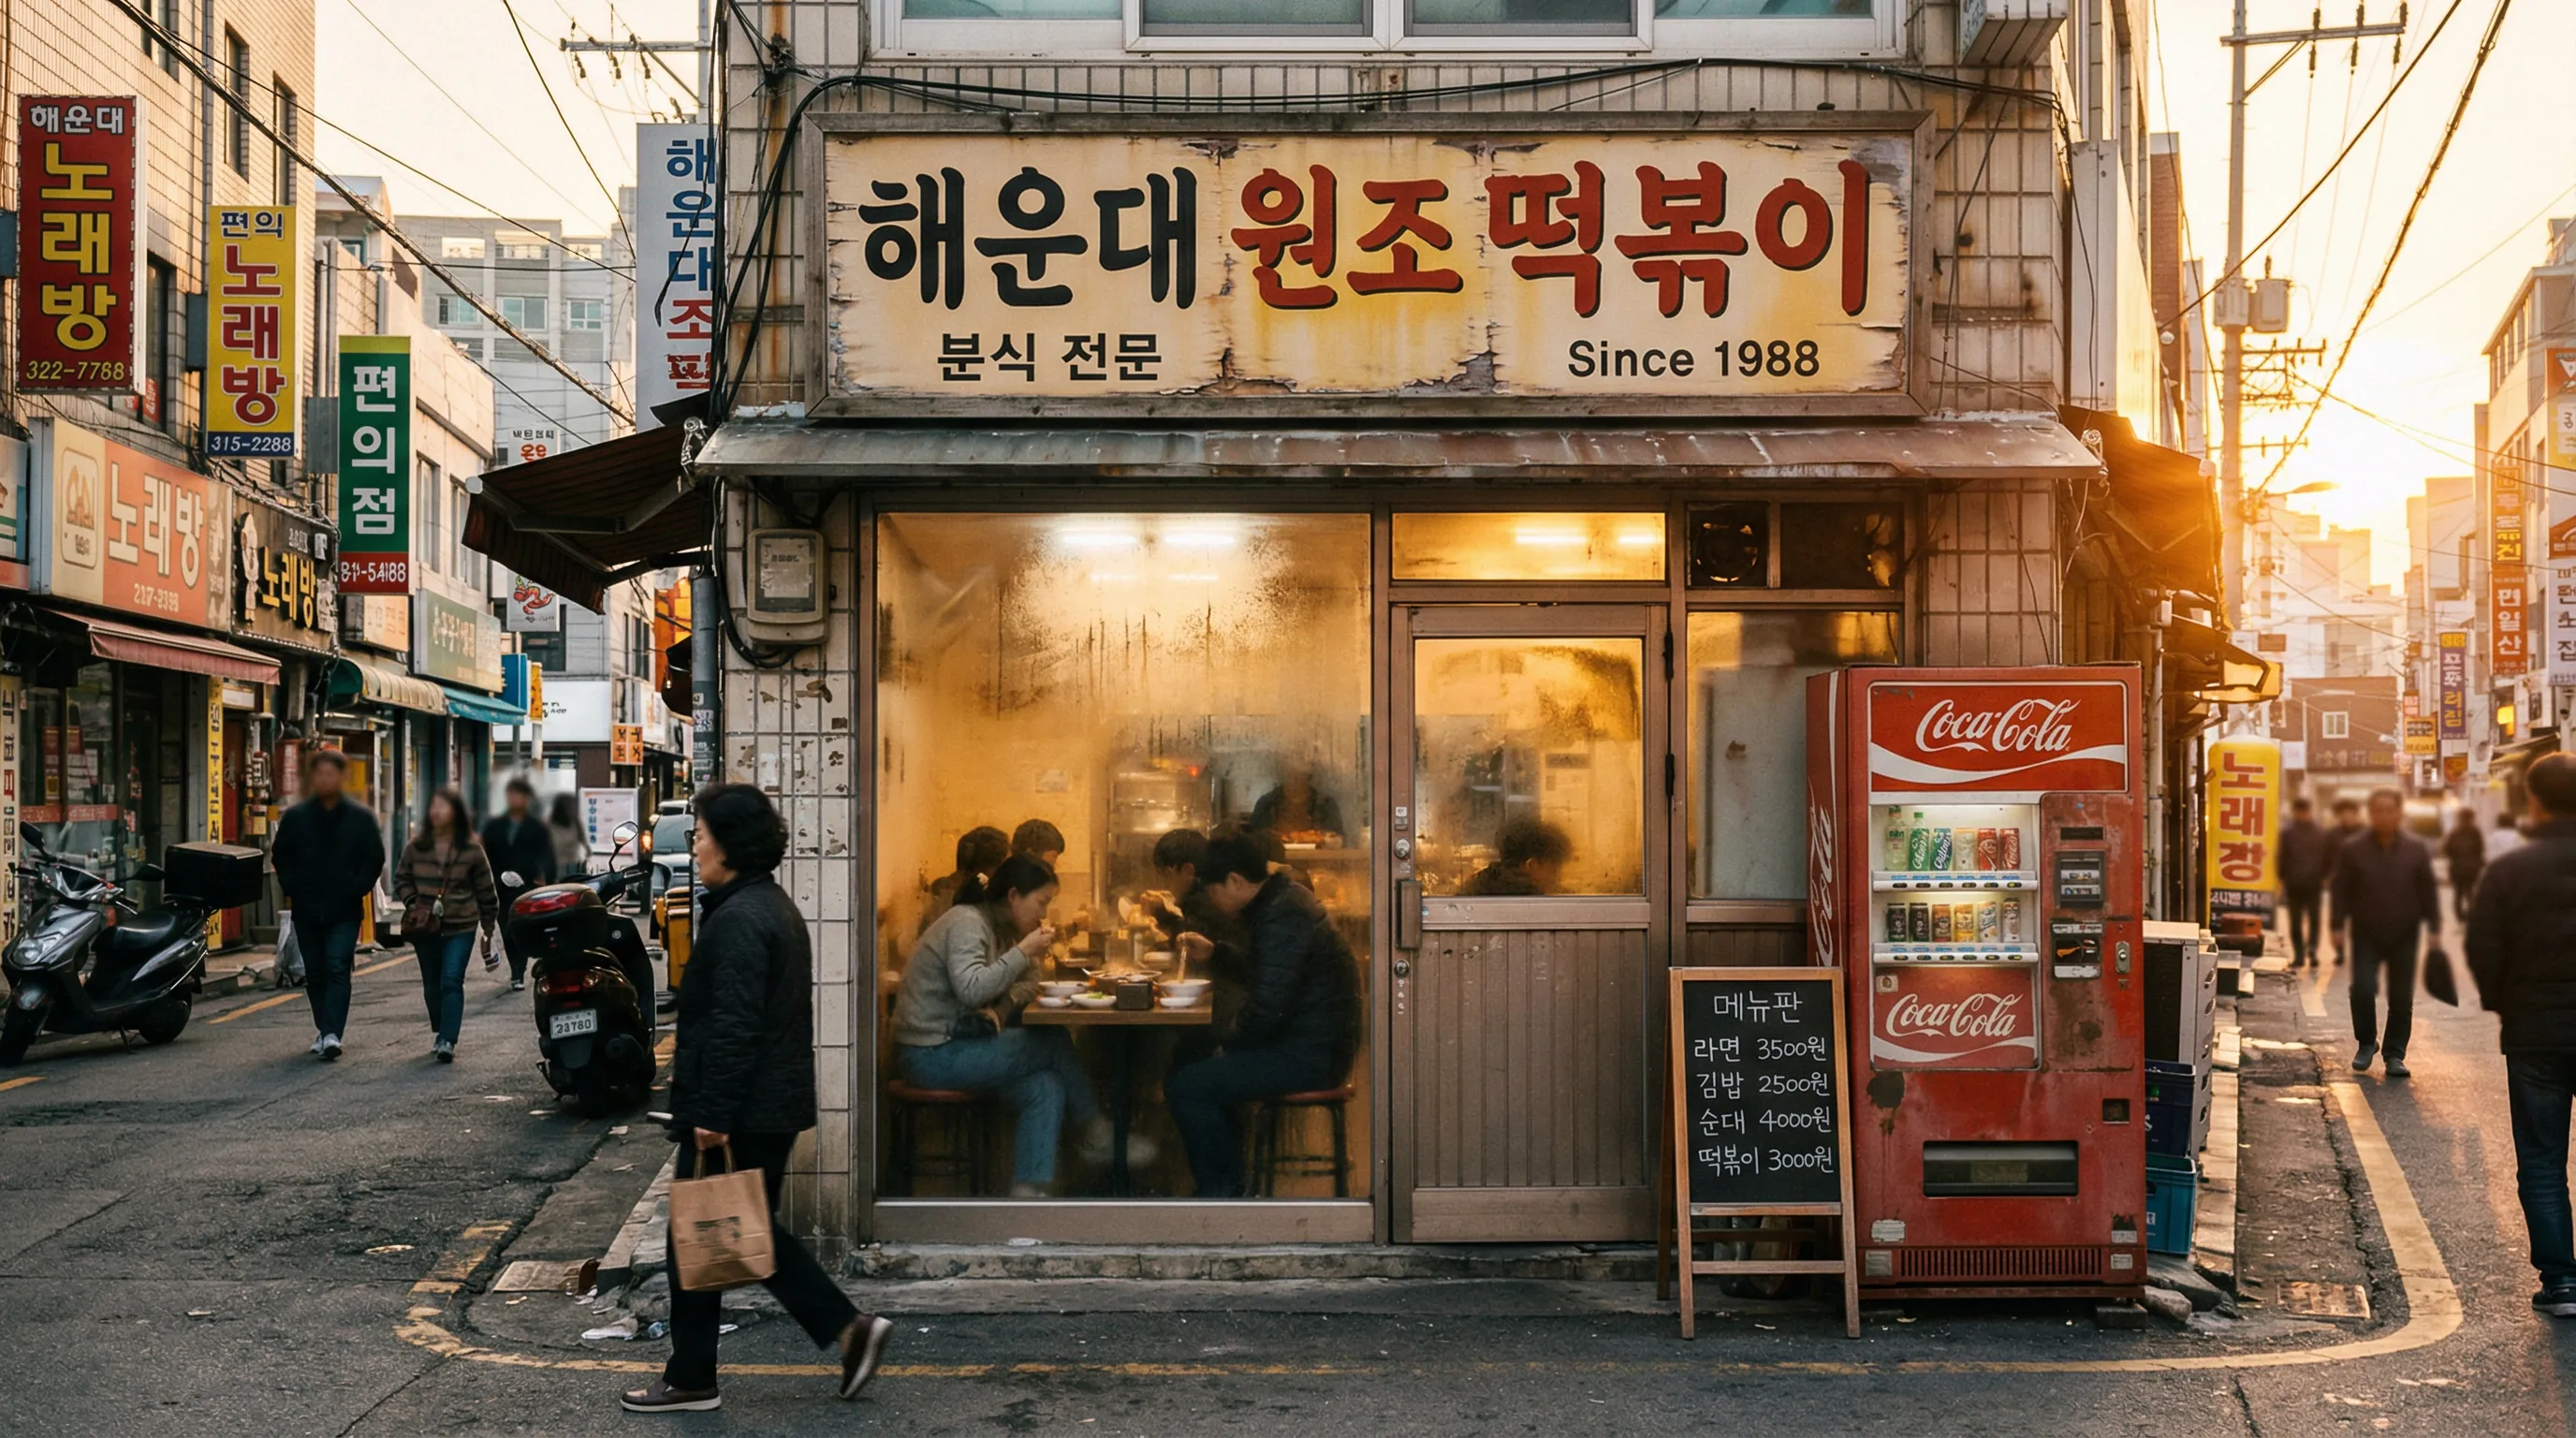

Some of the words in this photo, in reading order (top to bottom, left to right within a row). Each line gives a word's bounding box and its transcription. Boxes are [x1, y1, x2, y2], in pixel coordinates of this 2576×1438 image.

[31, 105, 123, 134] 해운대
[221, 212, 283, 238] 편의
[858, 167, 1196, 310] 해운대
[41, 143, 116, 350] 노래방
[222, 243, 286, 424] 노래방
[26, 360, 124, 380] 322-7768
[937, 333, 1035, 382] 분식
[1061, 333, 1162, 382] 전문
[1568, 340, 1694, 376] Since
[1715, 340, 1819, 376] 1988
[211, 435, 292, 452] 315-2288
[352, 366, 396, 535] 편의점
[108, 462, 203, 588] 노래방
[262, 546, 316, 628] 노래방
[1914, 698, 2082, 753] Coca-Cola
[1714, 990, 1803, 1023] 메뉴판
[1885, 992, 2024, 1038] Coca-Cola
[1694, 1035, 1740, 1063] 라면
[1756, 1035, 1826, 1062] 3500원
[1696, 1071, 1744, 1100] 김밥
[1759, 1071, 1830, 1097] 2500원
[1699, 1108, 1746, 1137] 순대
[1759, 1106, 1832, 1133] 4000원
[1698, 1143, 1759, 1177] 떡볶이
[1768, 1145, 1834, 1174] 3000원
